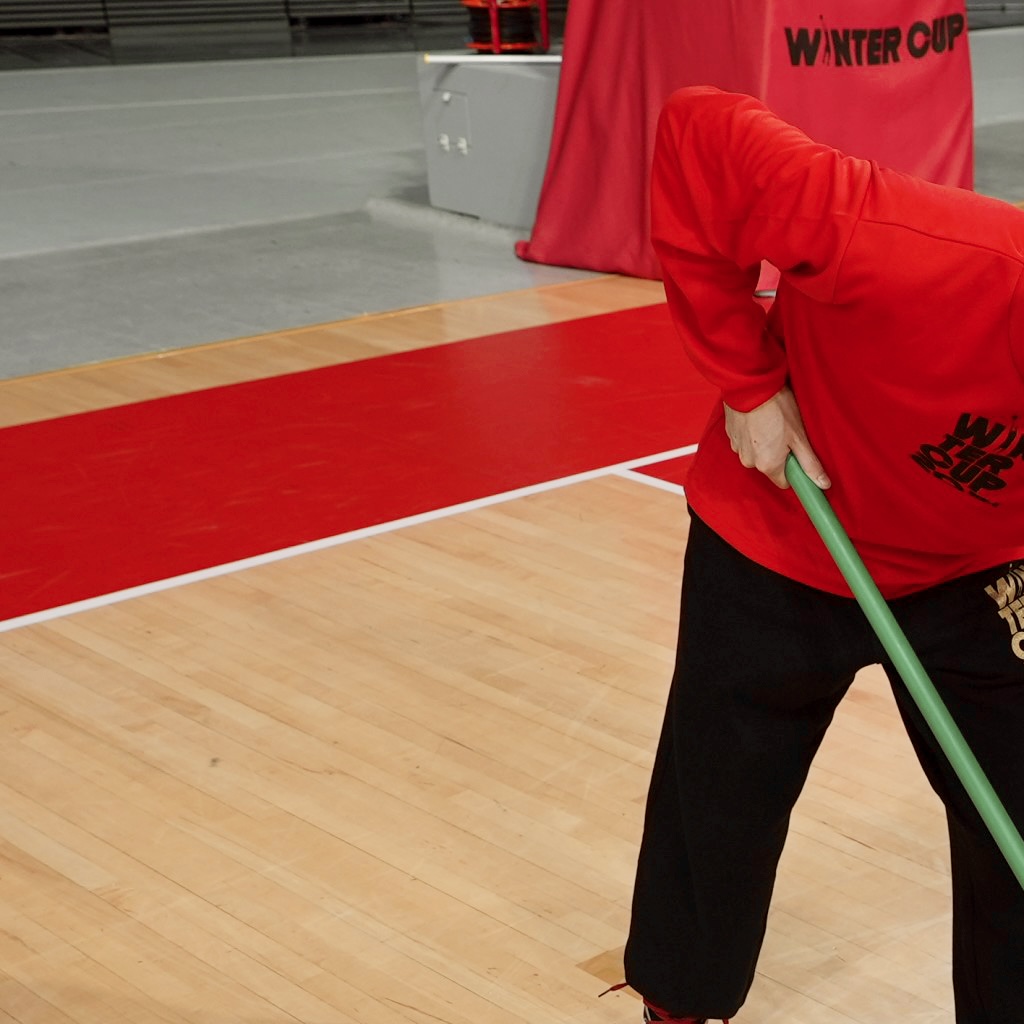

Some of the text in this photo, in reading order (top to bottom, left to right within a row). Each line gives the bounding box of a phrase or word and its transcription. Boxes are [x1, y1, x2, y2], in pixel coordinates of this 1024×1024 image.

[907, 13, 964, 59] CUP
[919, 443, 1007, 495] CUP
[939, 433, 1014, 475] TER
